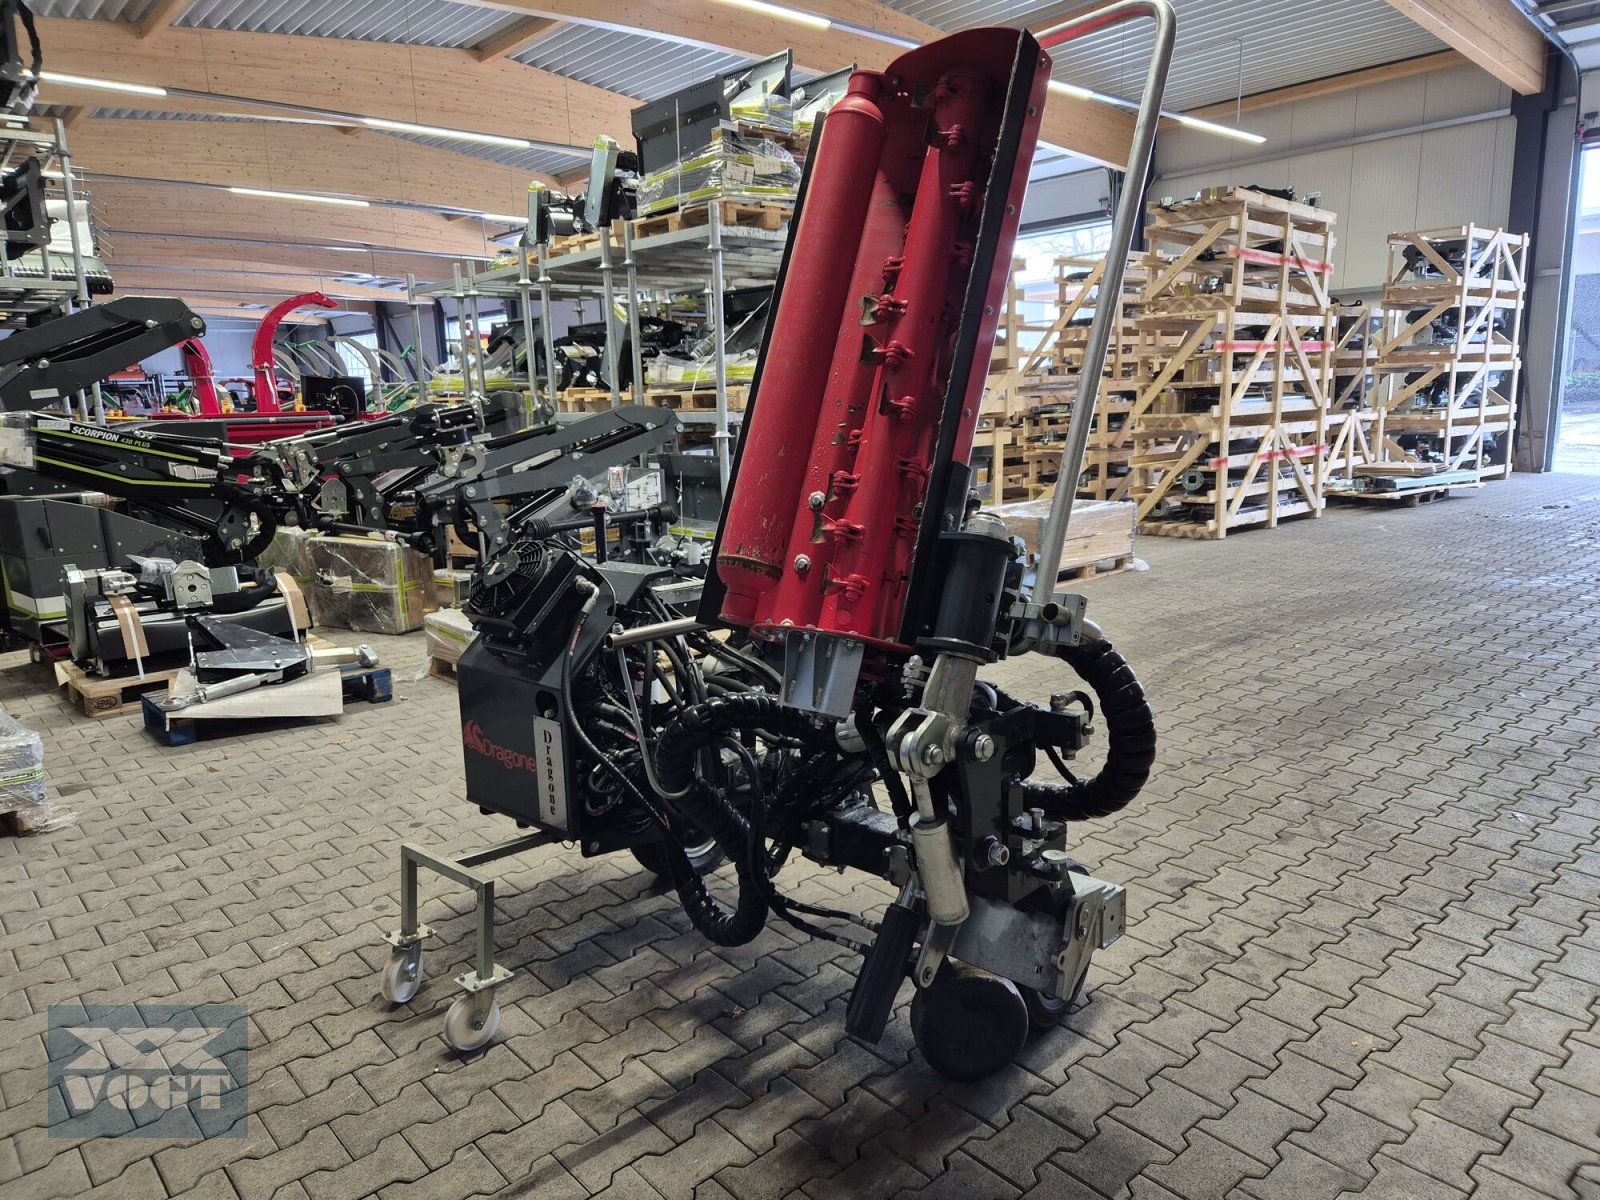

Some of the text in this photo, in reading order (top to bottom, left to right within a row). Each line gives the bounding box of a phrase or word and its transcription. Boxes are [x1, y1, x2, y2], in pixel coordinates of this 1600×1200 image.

[72, 425, 120, 443] SCORPION
[134, 440, 151, 448] PLUS
[483, 739, 537, 772] Dragone
[543, 730, 556, 816] Dragone
